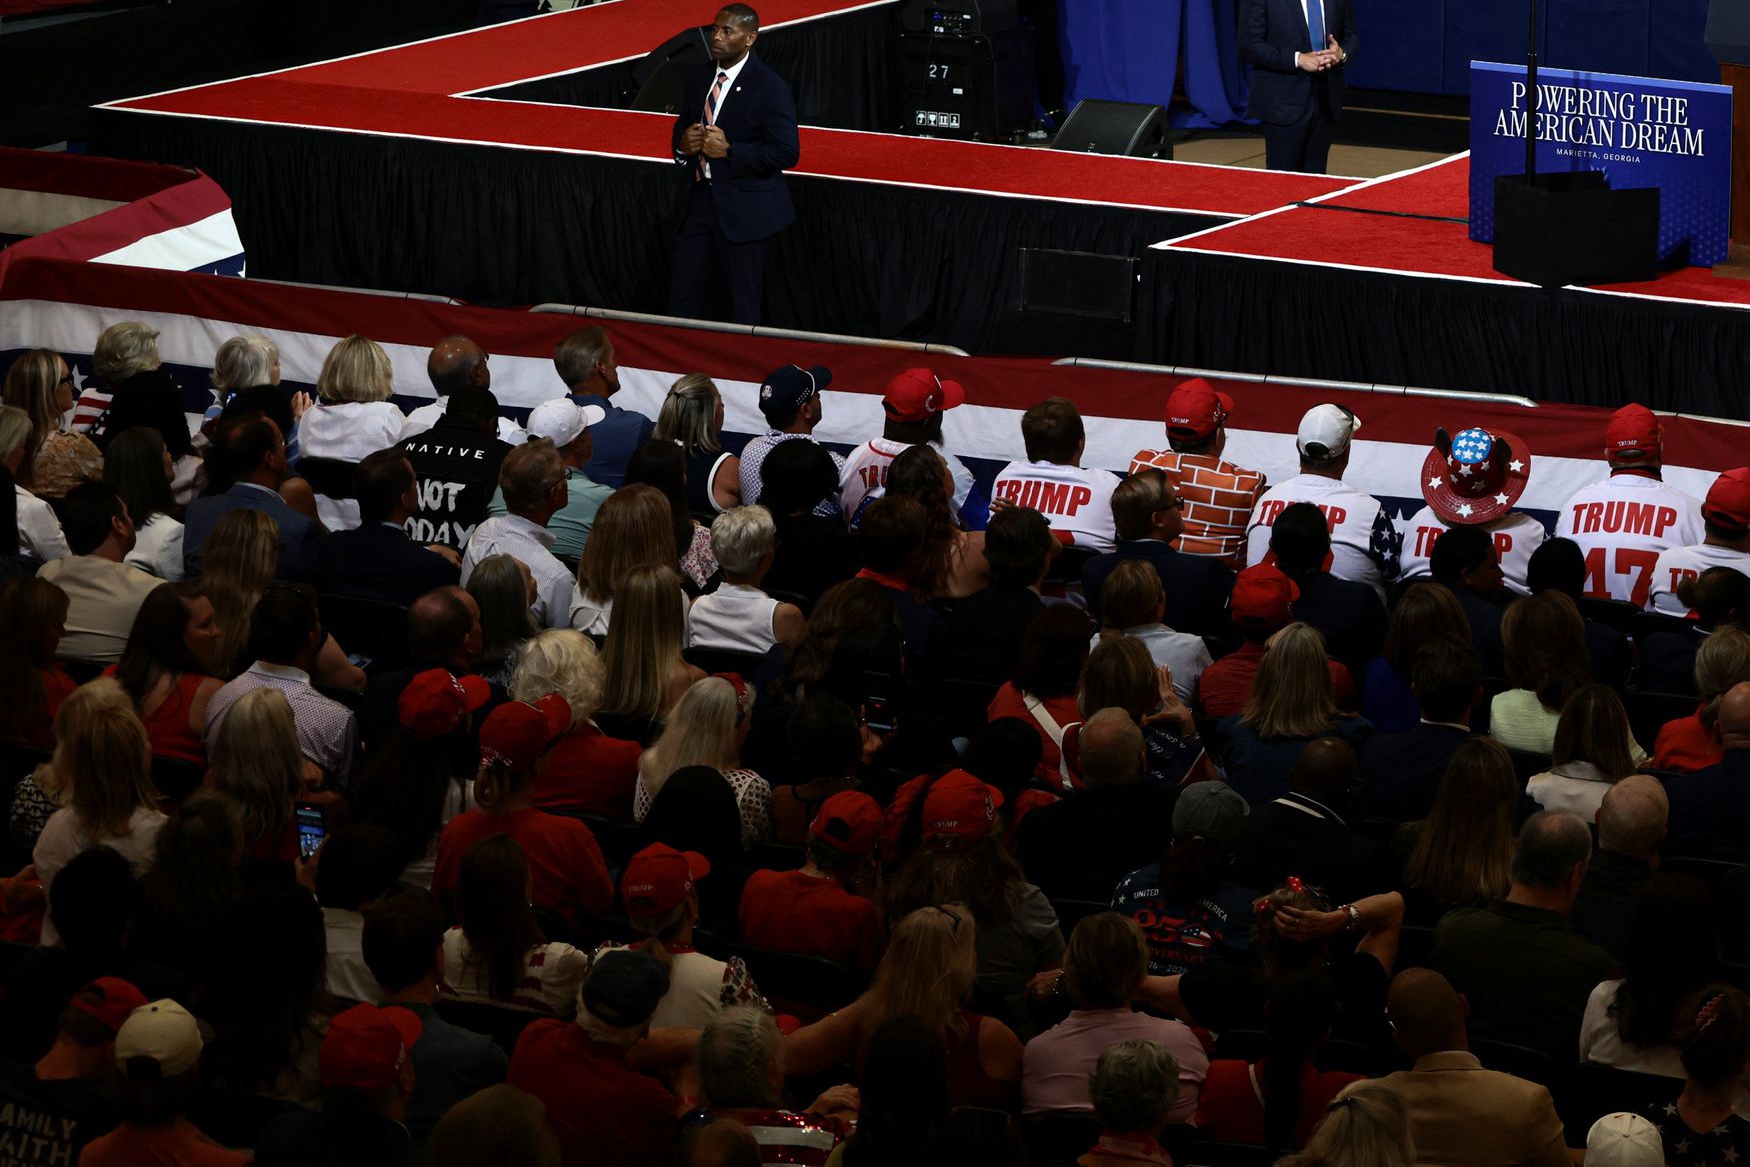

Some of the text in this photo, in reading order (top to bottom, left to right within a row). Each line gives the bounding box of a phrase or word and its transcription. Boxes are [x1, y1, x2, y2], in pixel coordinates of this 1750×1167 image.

[929, 64, 950, 79] 27
[1640, 92, 1689, 126] THE
[1557, 148, 1641, 164] MARIETTA, GEORGIA
[1620, 122, 1705, 157] DREAM
[404, 442, 486, 461] NATIVE
[1618, 439, 1638, 447] TRUMP
[858, 465, 887, 489] TRU
[416, 480, 467, 513] NOT
[996, 479, 1092, 517] TRUMP
[403, 516, 477, 549] ODAY
[1260, 500, 1347, 534] TRP
[1572, 502, 1677, 538] TRUMP
[1414, 525, 1513, 564] TRP
[1584, 547, 1662, 609] 47
[1133, 888, 1160, 900] UNITED
[2, 1103, 78, 1140] AMILY
[0, 1133, 74, 1167] AITH
